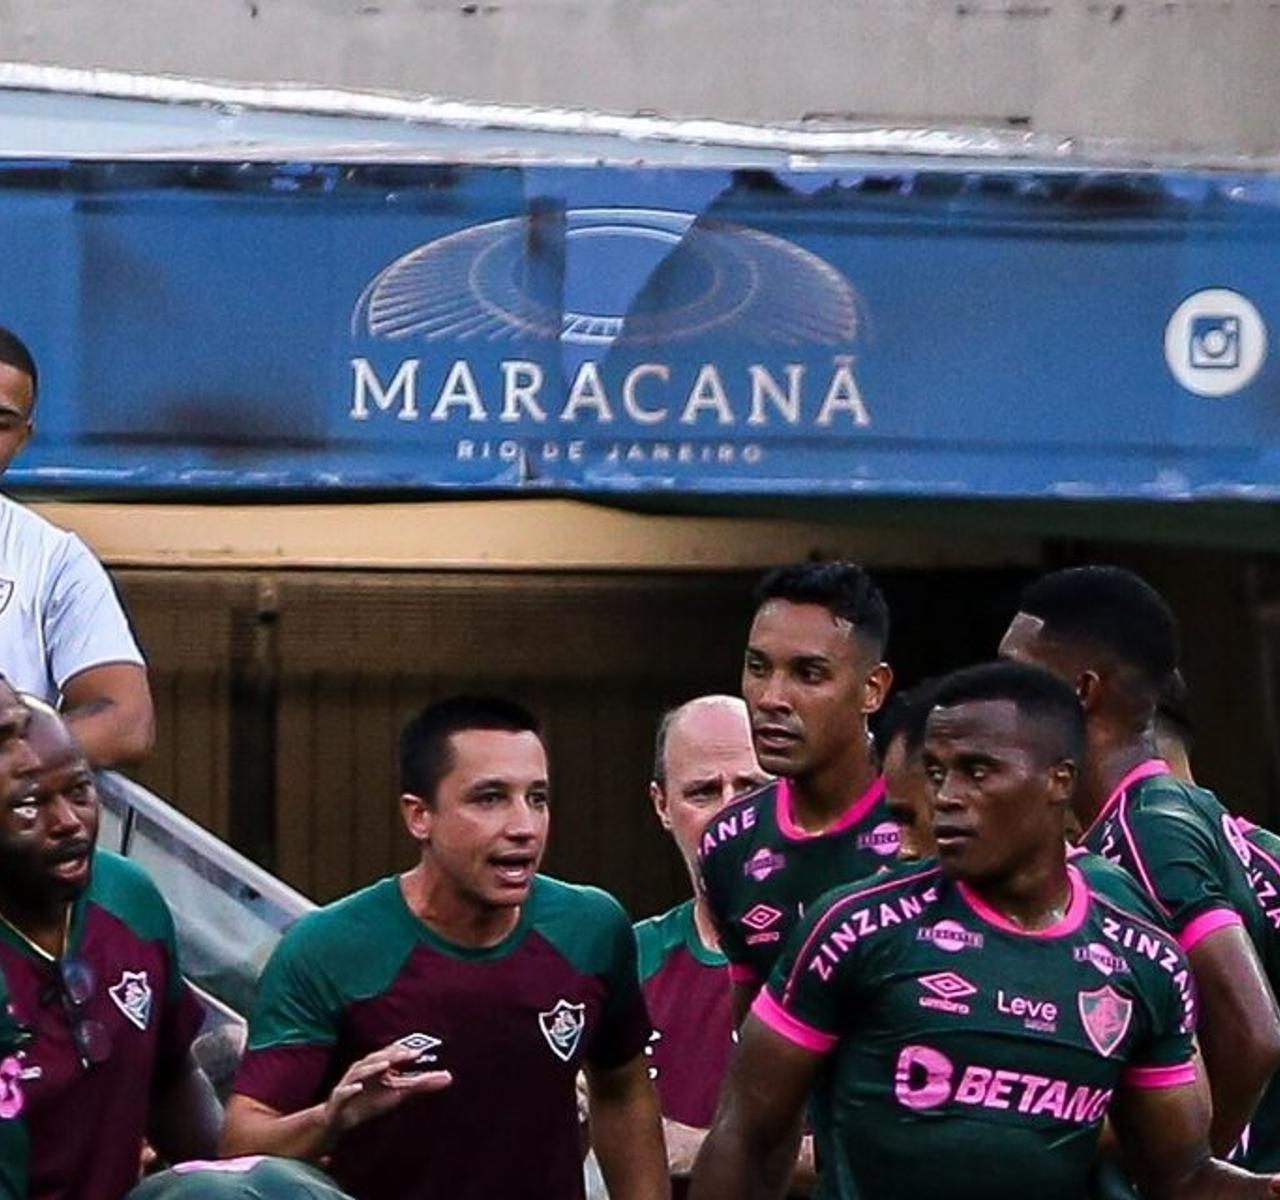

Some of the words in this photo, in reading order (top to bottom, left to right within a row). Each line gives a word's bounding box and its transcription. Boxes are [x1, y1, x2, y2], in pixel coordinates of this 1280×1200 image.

[456, 438, 518, 461] RIO
[543, 439, 584, 462] DE
[606, 441, 763, 464] JANEIRO
[998, 990, 1058, 1022] Leve
[955, 1065, 1116, 1123] BETANO
